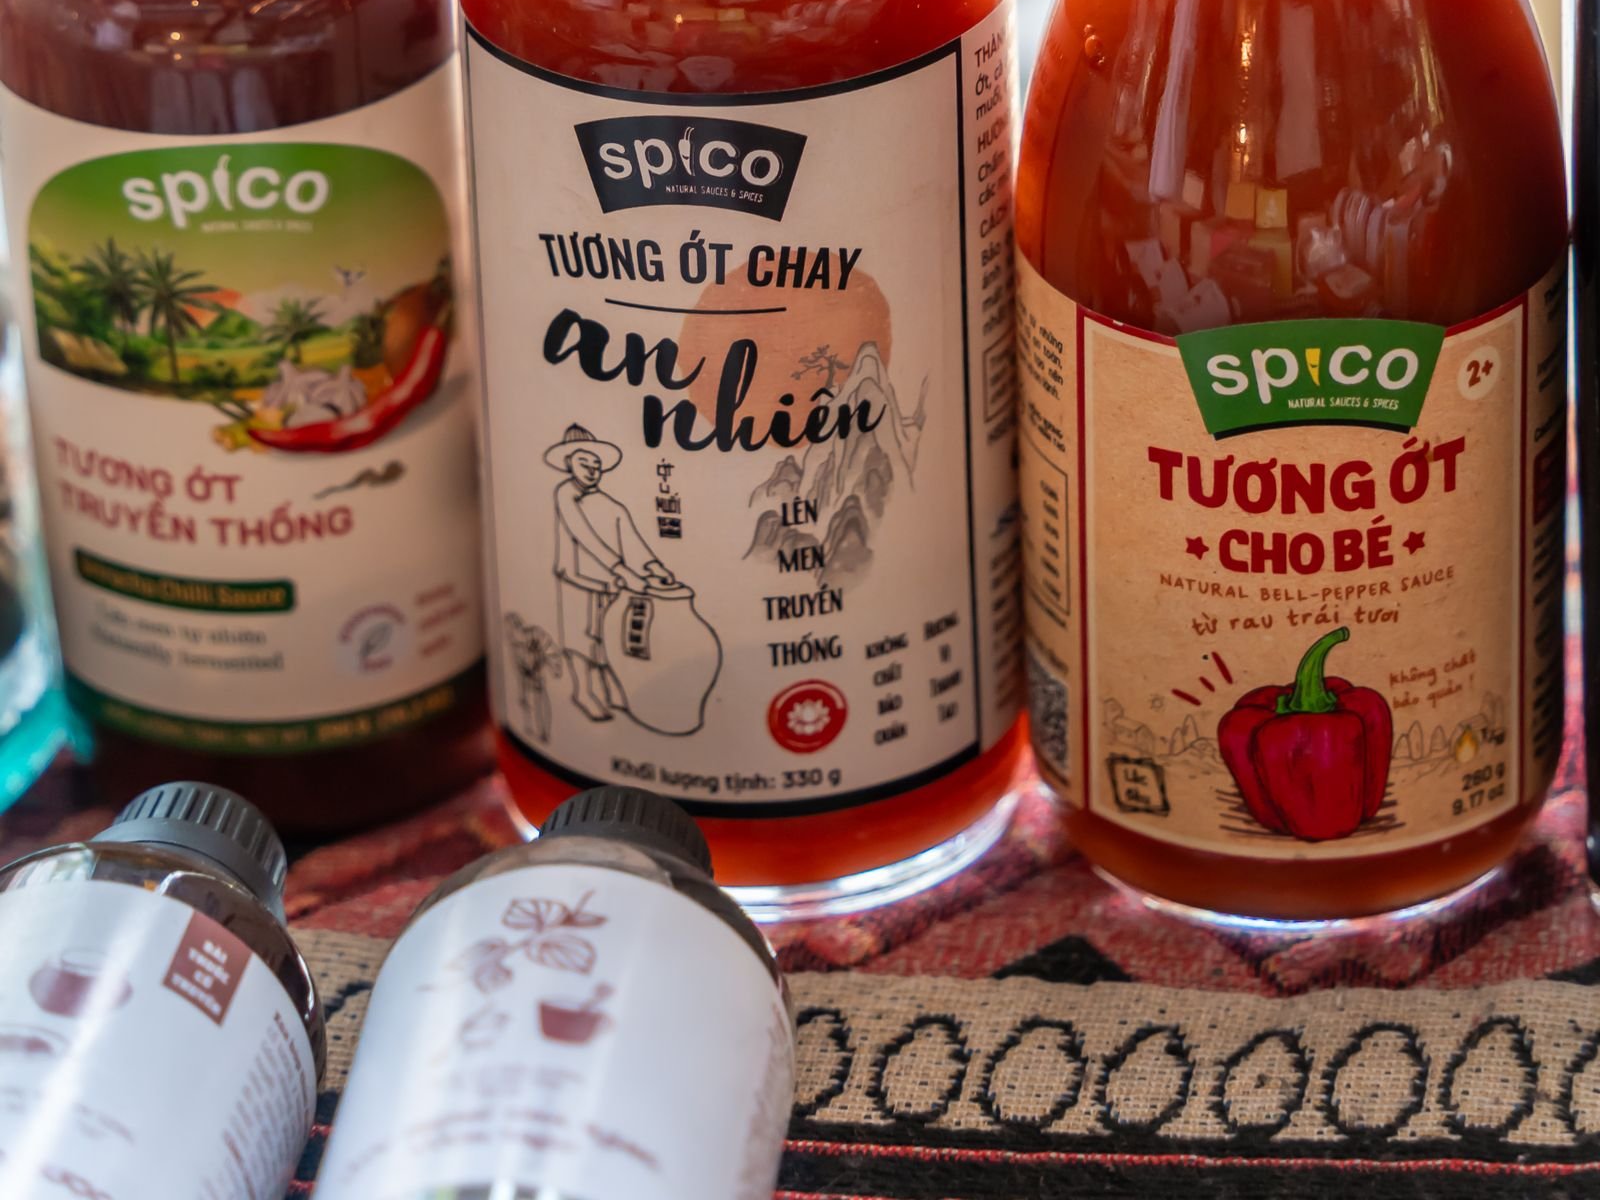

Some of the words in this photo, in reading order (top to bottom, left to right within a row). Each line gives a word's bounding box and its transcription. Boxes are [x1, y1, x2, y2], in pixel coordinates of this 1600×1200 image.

[600, 127, 783, 189] spico
[122, 154, 330, 230] spico
[665, 185, 697, 194] NATURAL
[701, 186, 728, 197] SAUCES
[738, 190, 764, 203] SPICES
[538, 231, 665, 282] TƯƠNG
[679, 230, 733, 285] ỚT
[747, 245, 863, 290] CHAY
[543, 308, 706, 390] an
[643, 339, 887, 453] nhiên
[1206, 345, 1419, 404] spico
[1467, 360, 1493, 388] 2+
[1288, 397, 1326, 409] NATURAL
[1329, 397, 1361, 408] SAUCES
[1372, 398, 1399, 411] SPICES
[54, 435, 174, 498] TƯƠNG
[186, 463, 242, 502] ỚT
[1148, 446, 1376, 515] TƯƠNG
[1389, 436, 1466, 504] ỚT
[209, 500, 354, 546] THỐNG
[781, 496, 818, 527] LÊN
[778, 545, 825, 573] MEN
[1219, 529, 1325, 575] CHO
[1333, 514, 1394, 572] BÉ
[1159, 573, 1249, 599] NATURAL
[1260, 581, 1392, 602] BELL-PEPPER
[1400, 565, 1455, 592] SAUCE
[1191, 612, 1219, 636] từ
[1230, 614, 1273, 631] rau
[1287, 604, 1340, 626] trái
[1354, 602, 1401, 625] tươi
[767, 632, 843, 668] THỐNG
[782, 767, 823, 789] 330
